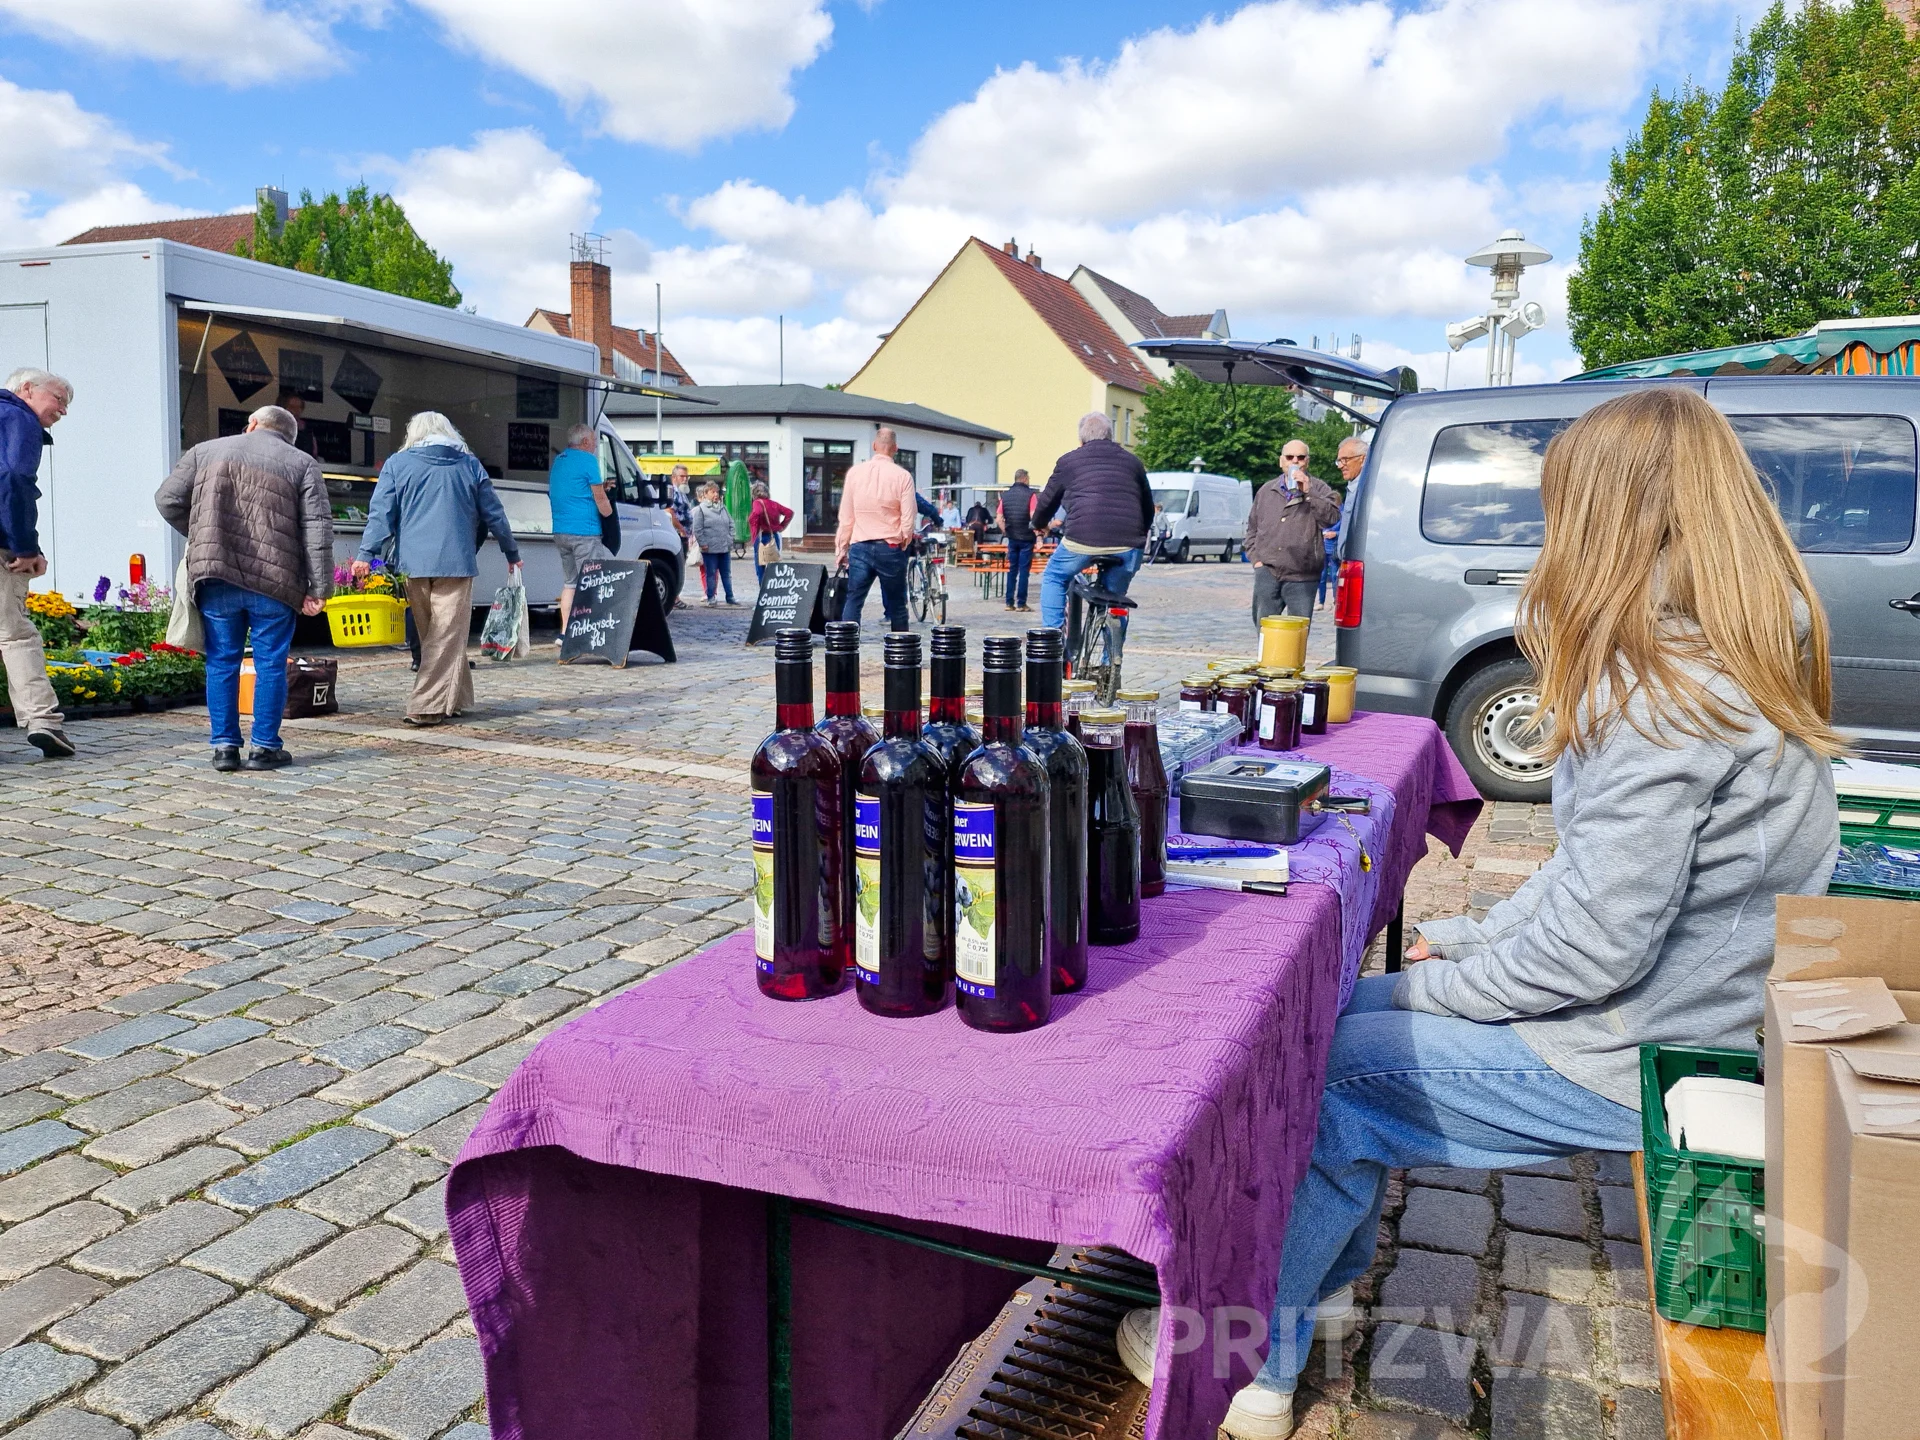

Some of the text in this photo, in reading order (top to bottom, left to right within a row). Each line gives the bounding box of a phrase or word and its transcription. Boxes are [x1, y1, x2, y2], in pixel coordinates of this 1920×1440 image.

[775, 564, 796, 579] Wir
[767, 578, 809, 594] machen
[759, 593, 802, 606] Sommer-
[762, 609, 796, 626] pause
[941, 1350, 984, 1401] FASERFIX
